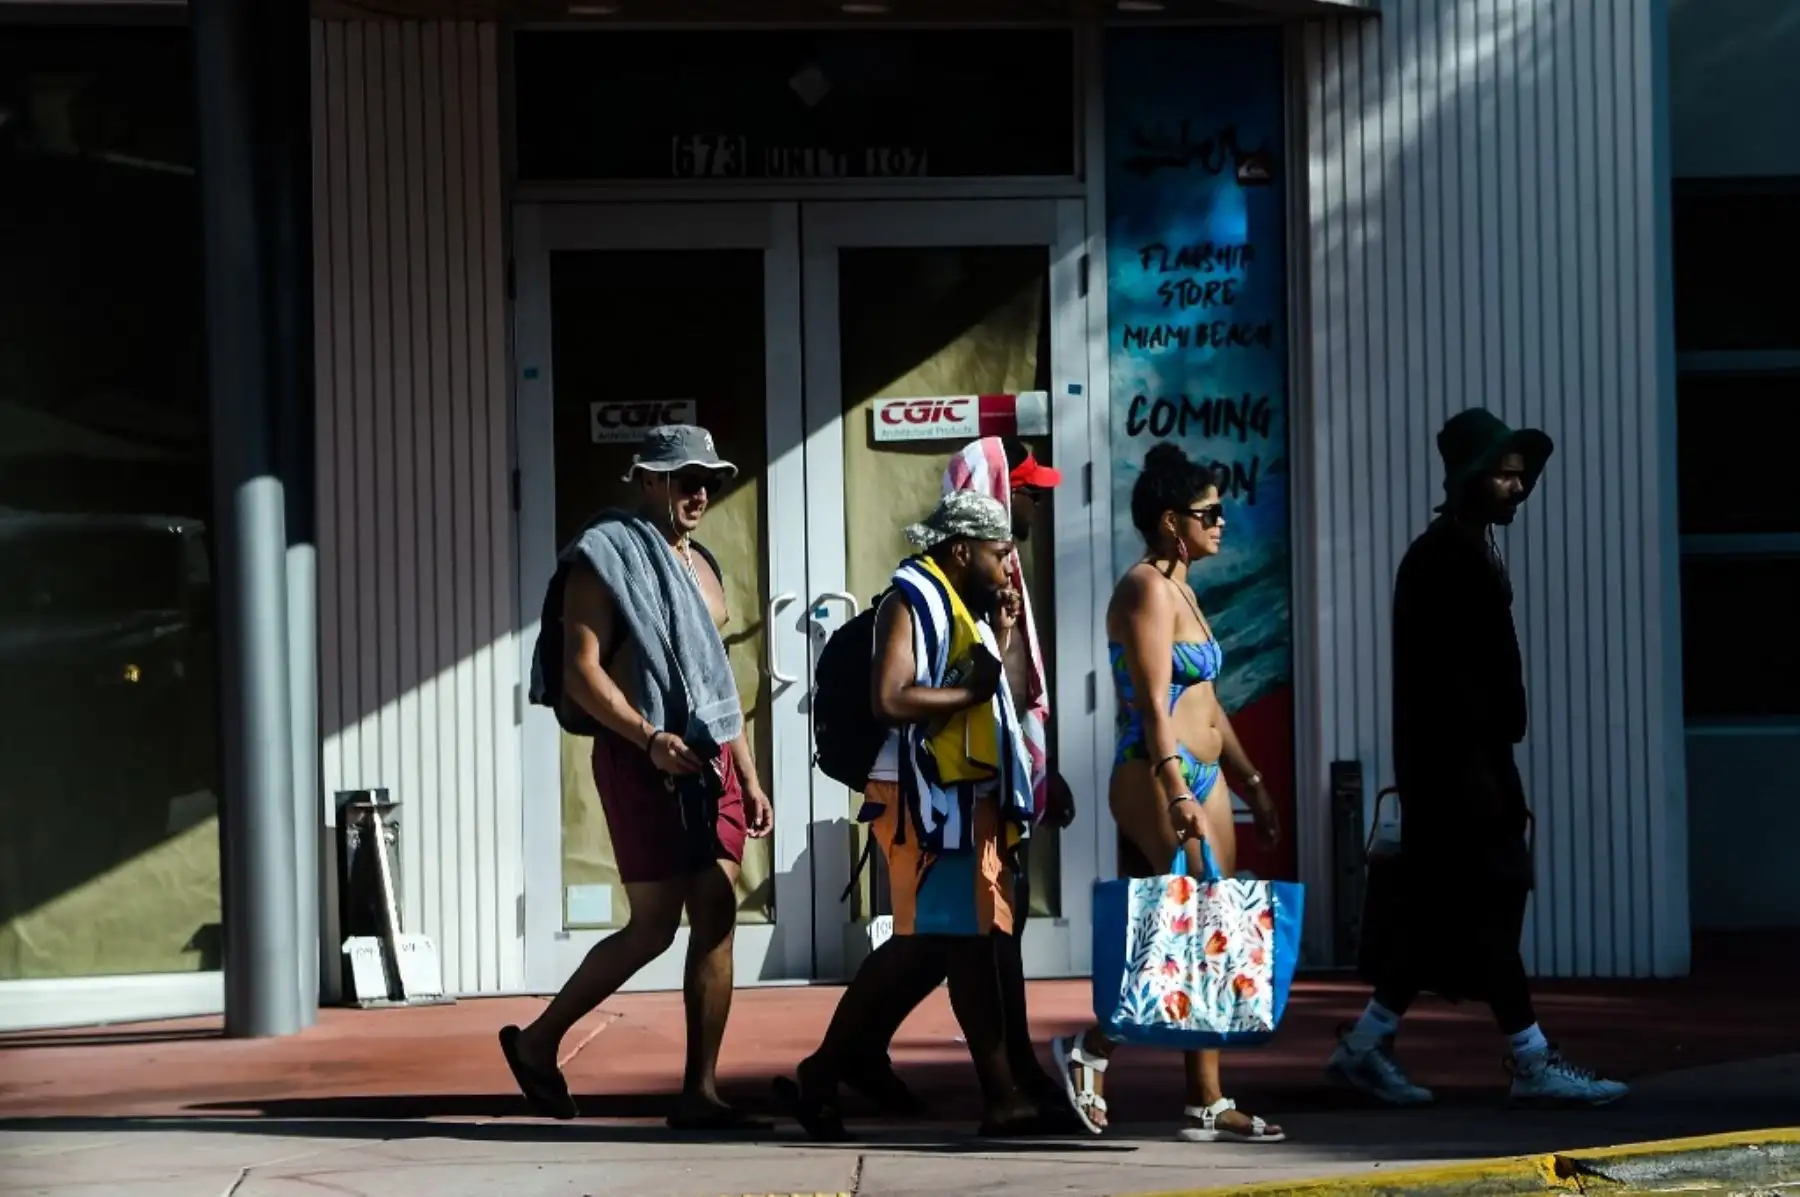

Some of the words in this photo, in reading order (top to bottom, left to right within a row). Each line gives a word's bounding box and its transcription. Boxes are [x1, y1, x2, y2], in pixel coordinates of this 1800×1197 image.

[675, 134, 744, 177] 673
[1157, 279, 1235, 310] STORE
[1122, 323, 1190, 349] MIAMI
[597, 403, 688, 428] CGIC
[881, 399, 970, 425] CGIC
[1127, 394, 1270, 442] COMING
